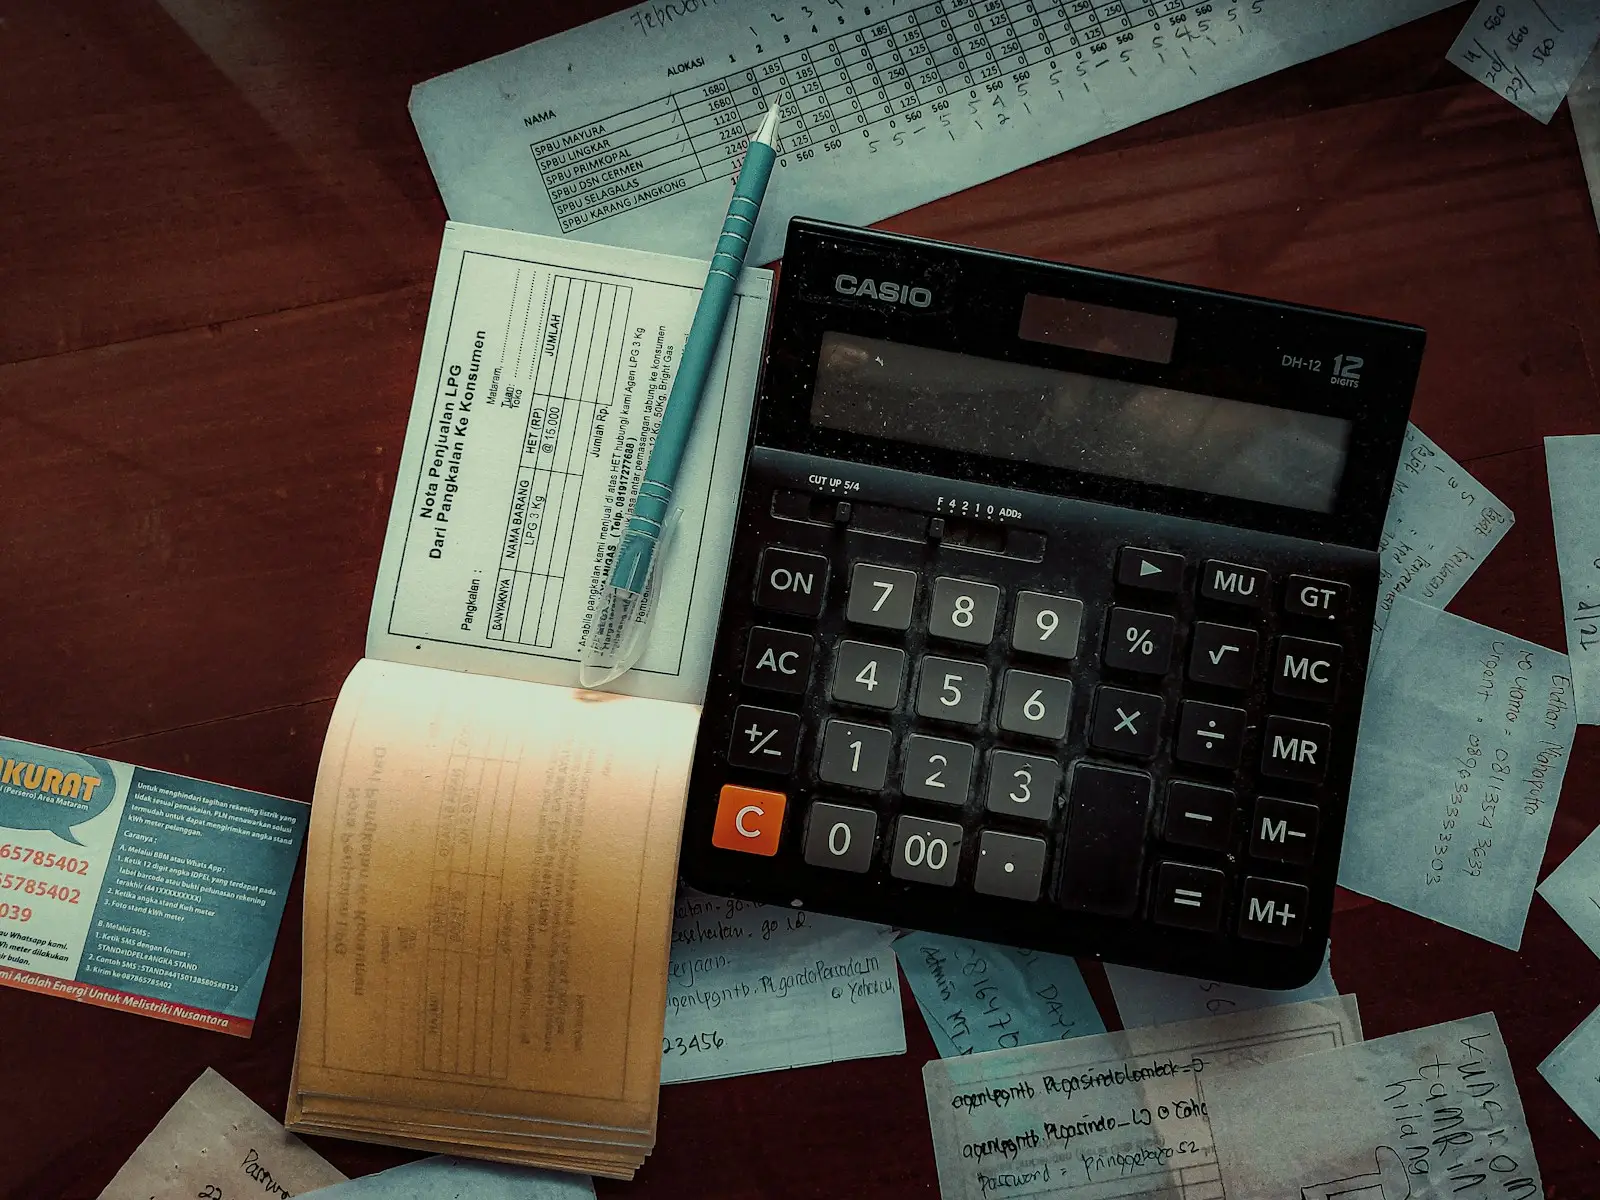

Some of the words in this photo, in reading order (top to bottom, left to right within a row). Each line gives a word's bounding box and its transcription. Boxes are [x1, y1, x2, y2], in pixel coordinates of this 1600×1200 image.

[524, 110, 557, 127] NAMA
[667, 56, 705, 77] ALOKASI
[702, 82, 726, 97] 1680
[708, 97, 731, 111] 1680
[713, 111, 737, 126] 1120
[719, 125, 743, 140] 2240
[796, 149, 814, 162] 560
[824, 139, 842, 152] 560
[905, 110, 922, 123] 560
[931, 100, 949, 113] 560
[535, 140, 561, 156] SPBU
[562, 125, 606, 146] MAYURA
[540, 155, 566, 170] SPBU
[567, 139, 611, 160] LINGKAR
[725, 140, 748, 155] 2240
[791, 134, 809, 147] 125
[546, 169, 572, 185] SPBU
[573, 149, 632, 175] PRIMKOPAL
[551, 184, 577, 200] SPBU
[578, 175, 600, 190] DSN
[601, 160, 644, 182] CERMEN
[557, 198, 583, 215] SPBU
[584, 178, 640, 205] SELAGALAS
[562, 213, 588, 229] SPBU
[589, 198, 632, 219] KARANG
[633, 178, 686, 204] JANGKONG
[834, 274, 933, 309] CASIO
[545, 314, 561, 357] JUMLAH
[634, 327, 646, 339] Kg
[650, 325, 666, 370] konsumen
[459, 331, 486, 412] Konsumen
[629, 349, 640, 368] LPG
[1281, 354, 1322, 374] DH-12
[1331, 353, 1365, 379] 12
[445, 365, 461, 397] LPG
[624, 370, 636, 393] Agen
[648, 371, 658, 382] ke
[1329, 376, 1360, 389] DIGITS
[510, 389, 523, 409] Toko
[620, 394, 632, 415] kami
[643, 384, 658, 413] tabung
[454, 417, 469, 437] Ke
[530, 408, 545, 430] (RP)
[596, 408, 609, 422] Rp.
[428, 402, 455, 478] Penjualan
[525, 432, 538, 454] HET
[590, 424, 604, 458] Jumlah
[614, 416, 630, 451] hubungi
[635, 416, 651, 471] pemasangan
[524, 522, 538, 545] LPG
[531, 495, 547, 509] Kg
[544, 407, 560, 440] 15.000
[610, 453, 621, 472] HET
[436, 442, 464, 522] Pangkalan
[608, 475, 618, 493] atas
[808, 474, 827, 486] CUT
[829, 477, 843, 488] UP
[843, 480, 861, 492] 5/4
[419, 483, 438, 518] Nota
[512, 480, 530, 525] BARANG
[605, 495, 614, 503] di
[937, 496, 945, 507] F
[949, 499, 957, 509] 4
[961, 501, 969, 511] 2
[975, 503, 981, 513] 1
[987, 505, 995, 515] 0
[600, 505, 612, 540] menjual
[611, 512, 624, 530] Telp.
[429, 527, 446, 559] Dari
[505, 528, 521, 559] NAMA
[594, 542, 605, 563] kami
[587, 565, 601, 611] pangkalan
[770, 568, 814, 595] ON
[871, 581, 895, 612] 7
[1213, 569, 1255, 596] MU
[460, 579, 480, 631] Pangkalan
[492, 579, 510, 631] BANYAKNYA
[951, 595, 976, 628] 8
[1300, 586, 1337, 611] GT
[1035, 609, 1060, 641] 9
[1126, 626, 1154, 656] %
[756, 647, 800, 676] AC
[855, 660, 879, 692] 4
[1283, 654, 1331, 684] MC
[938, 673, 964, 707] 5
[1022, 688, 1047, 722] 6
[849, 740, 863, 772] 1
[1271, 735, 1318, 765] MR
[924, 754, 948, 789] 2
[1009, 769, 1033, 804] 3
[3, 786, 37, 800] (Persero)
[37, 794, 54, 803] Area
[55, 797, 88, 811] Mataram
[137, 782, 158, 792] Untuk
[279, 815, 296, 824] yang
[735, 805, 765, 838] C
[828, 821, 852, 856] 0
[904, 834, 948, 871] 00
[0, 874, 81, 904] 5785402
[1248, 897, 1296, 927] M+
[9, 945, 31, 953] meter
[32, 948, 69, 962] dilakukan
[10, 931, 46, 946] Whatsapp
[47, 939, 67, 949] kami.
[7, 954, 29, 965] bulan.
[12, 973, 52, 989] Adalah
[52, 981, 89, 997] Energi
[89, 988, 121, 1003] Untuk
[121, 996, 173, 1014] Melistriki
[173, 1007, 229, 1027] Nusantara
